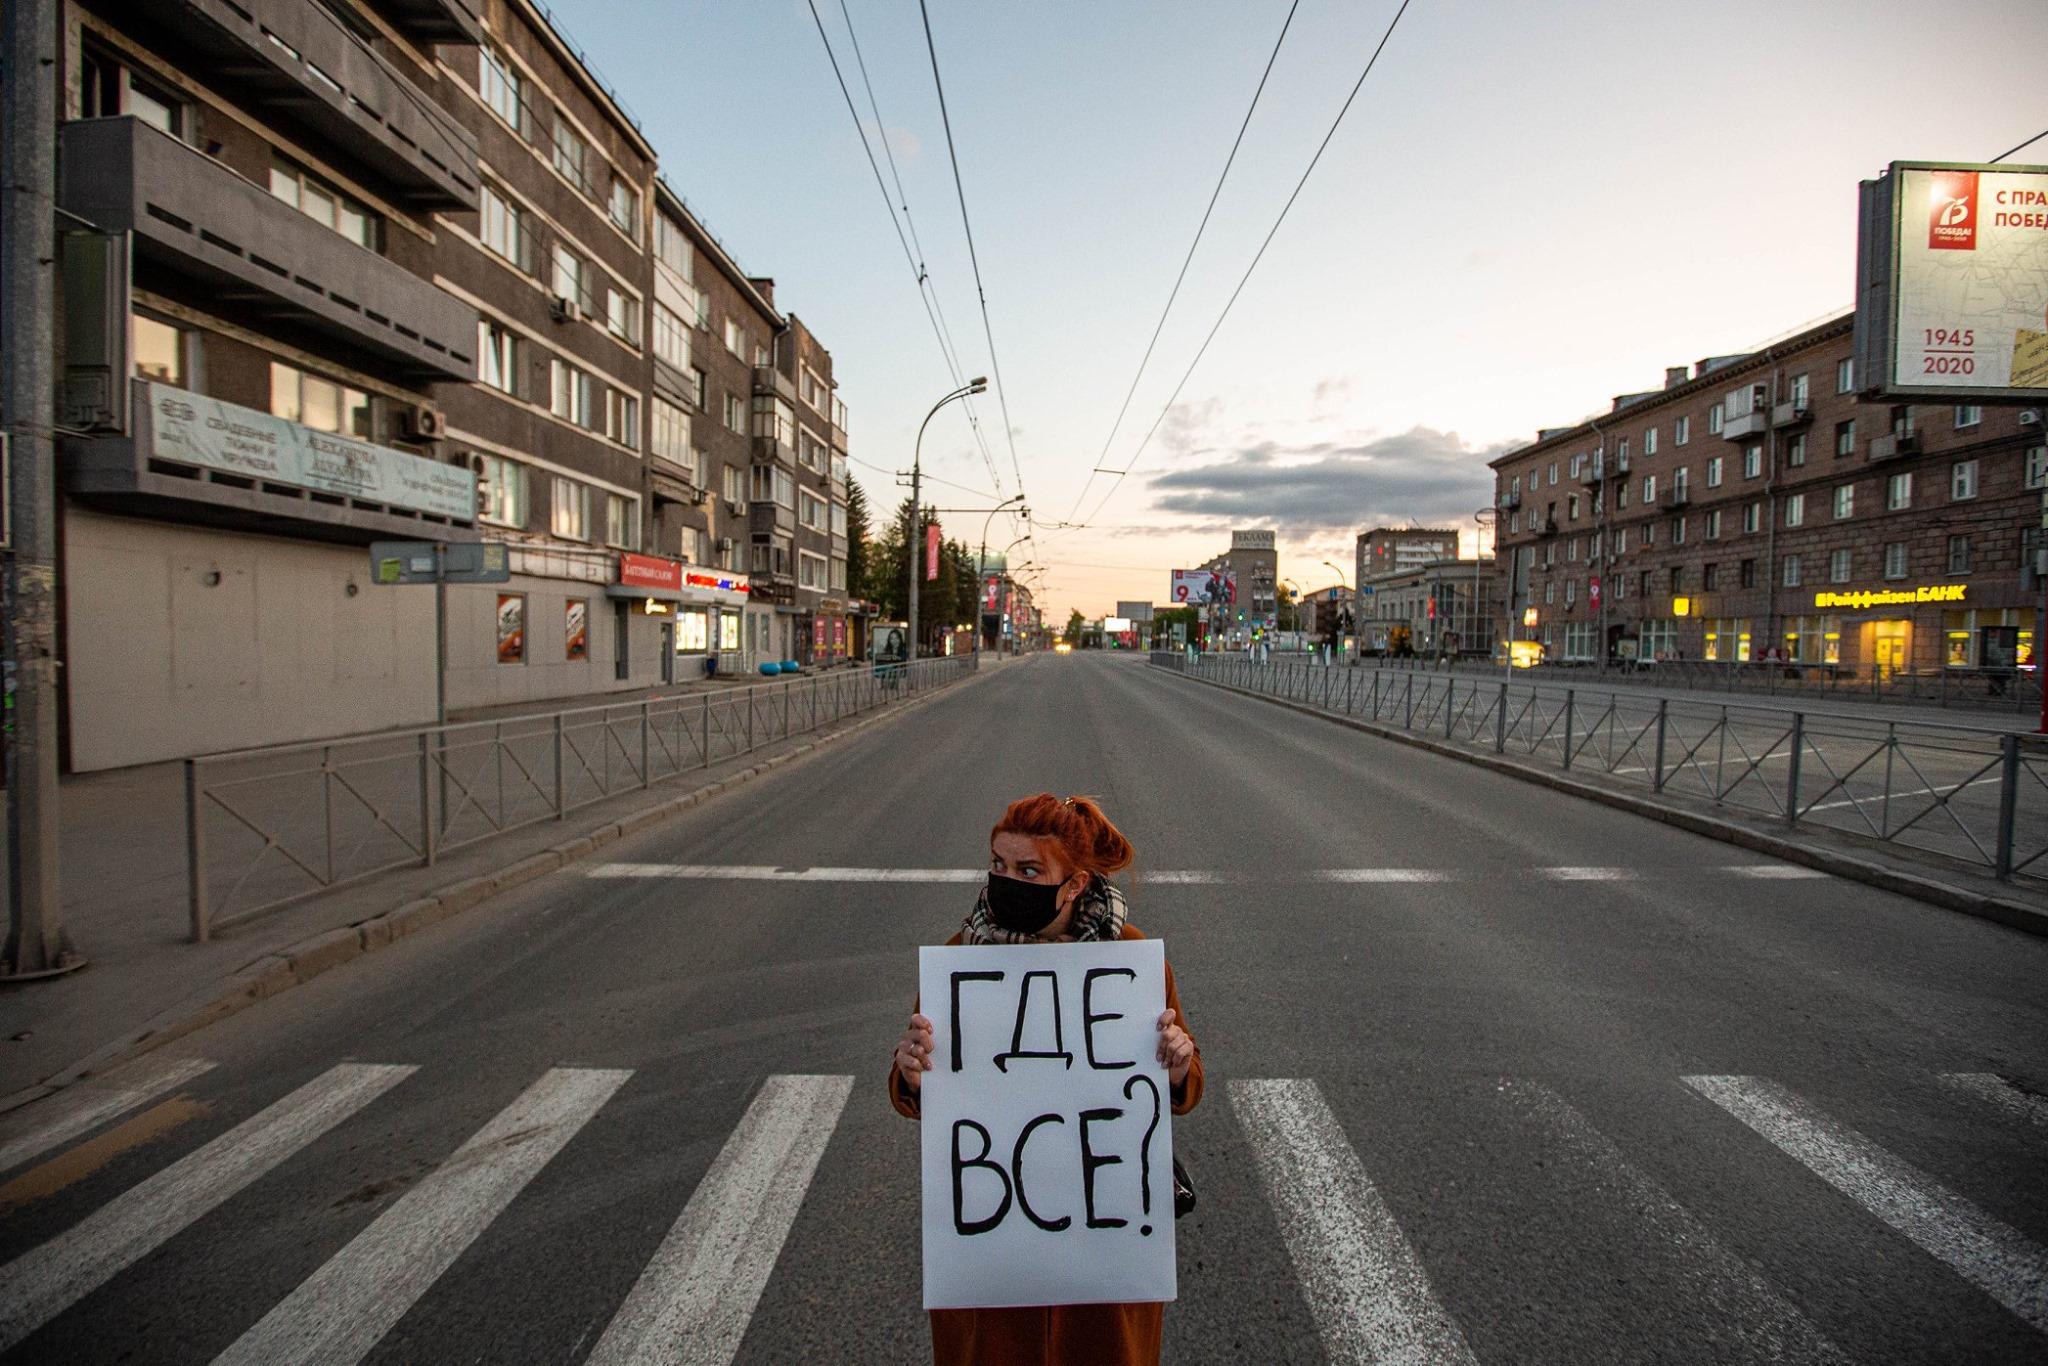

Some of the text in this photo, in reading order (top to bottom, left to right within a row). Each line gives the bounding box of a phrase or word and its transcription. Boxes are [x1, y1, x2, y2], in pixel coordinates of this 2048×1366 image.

[1996, 191, 2006, 204] С
[1925, 329, 1974, 346] 1945
[1924, 357, 1974, 374] 2020
[1917, 585, 1967, 602] БАНК
[950, 968, 1137, 1073] ГДЕ
[952, 1074, 1161, 1236] ВСЕ?
